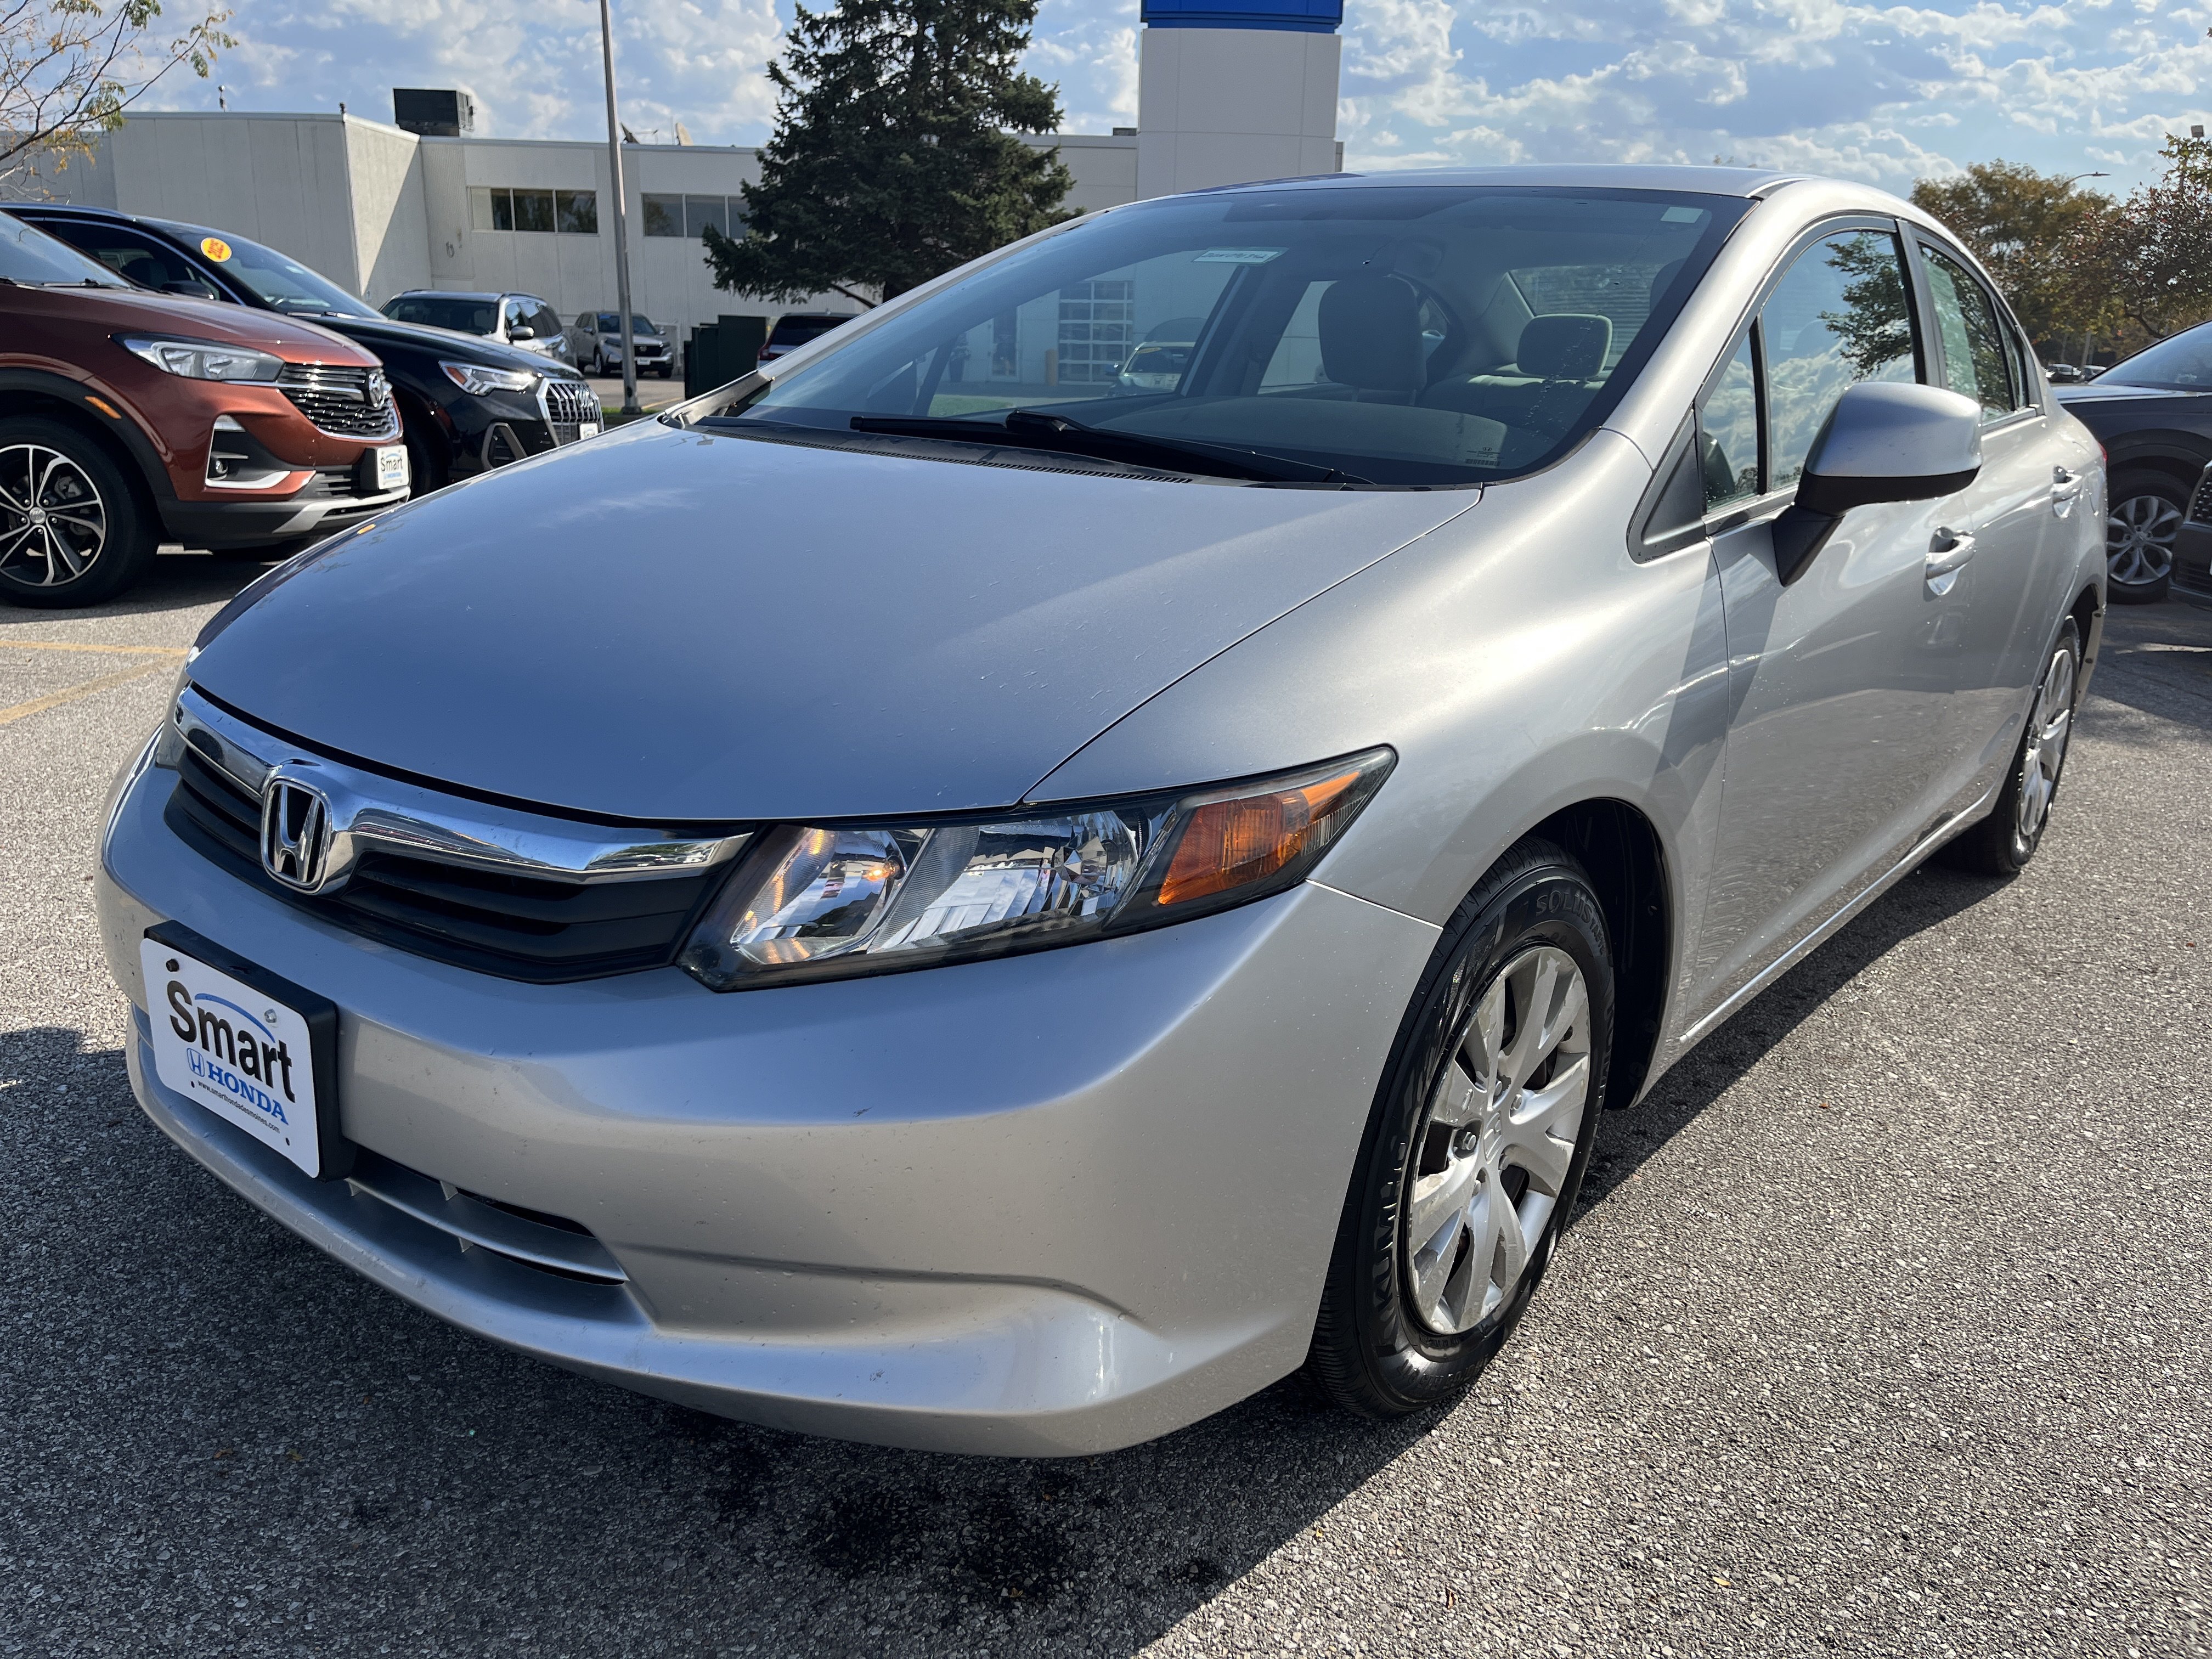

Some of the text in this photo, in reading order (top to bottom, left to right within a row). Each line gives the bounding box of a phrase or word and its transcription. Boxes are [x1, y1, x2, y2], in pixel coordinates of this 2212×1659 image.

[381, 456, 403, 472] Smart
[167, 980, 296, 1103] Smart
[206, 1060, 289, 1125] HONDA
